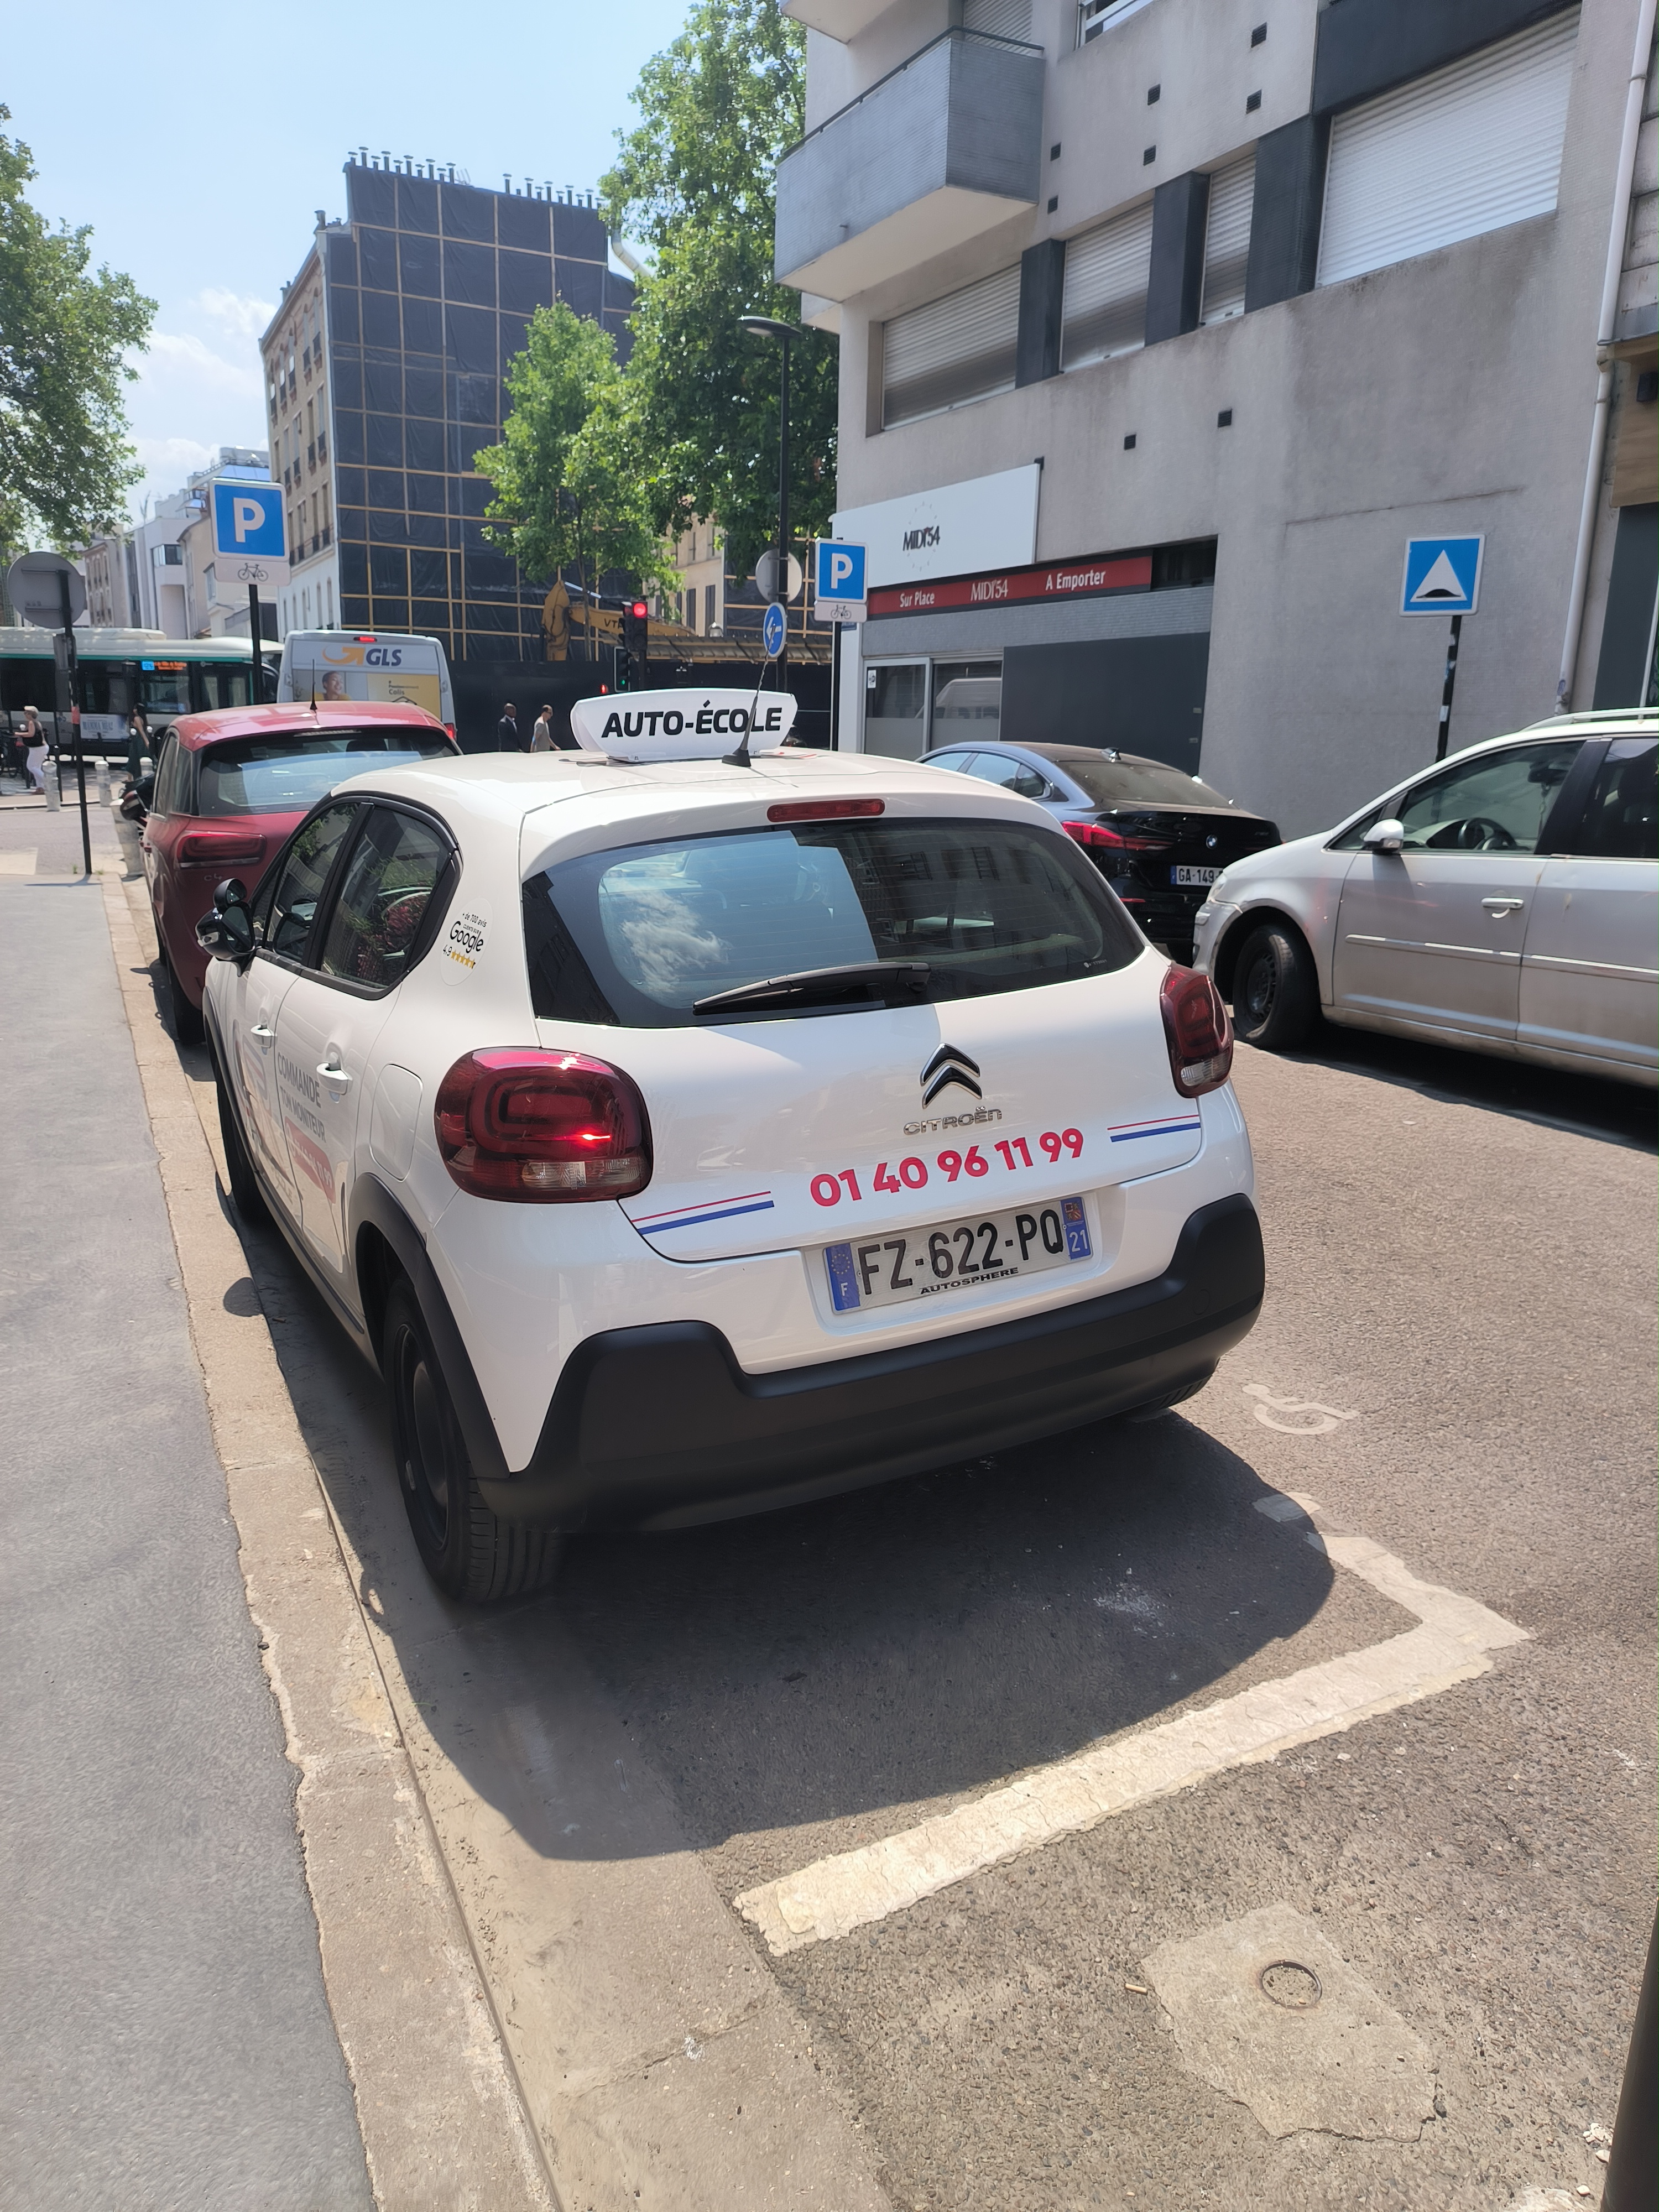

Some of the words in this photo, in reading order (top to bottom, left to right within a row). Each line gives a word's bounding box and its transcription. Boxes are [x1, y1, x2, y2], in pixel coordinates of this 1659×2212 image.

[233, 498, 265, 542] P
[831, 553, 853, 589] P
[1045, 574, 1053, 591] A
[1056, 570, 1106, 591] Emporter
[900, 593, 913, 607] Sur
[914, 590, 935, 606] Place
[366, 648, 402, 666] GLS
[601, 700, 782, 738] AUTO-ÉCOLE
[470, 914, 479, 924] 700
[477, 919, 487, 927] avis
[450, 921, 484, 954] Google
[278, 1052, 321, 1108] COMMANDE
[293, 1100, 327, 1144] MONITEUR
[810, 1168, 862, 1207] 01
[873, 1156, 929, 1193] 40
[937, 1145, 989, 1183] 96
[995, 1136, 1034, 1171] 11
[1039, 1128, 1084, 1163] 99
[857, 1209, 1065, 1296] FZ-622-PQ
[1069, 1229, 1088, 1252] 21
[841, 1282, 848, 1296] F
[920, 1267, 1019, 1295] AUTOSPHERE
